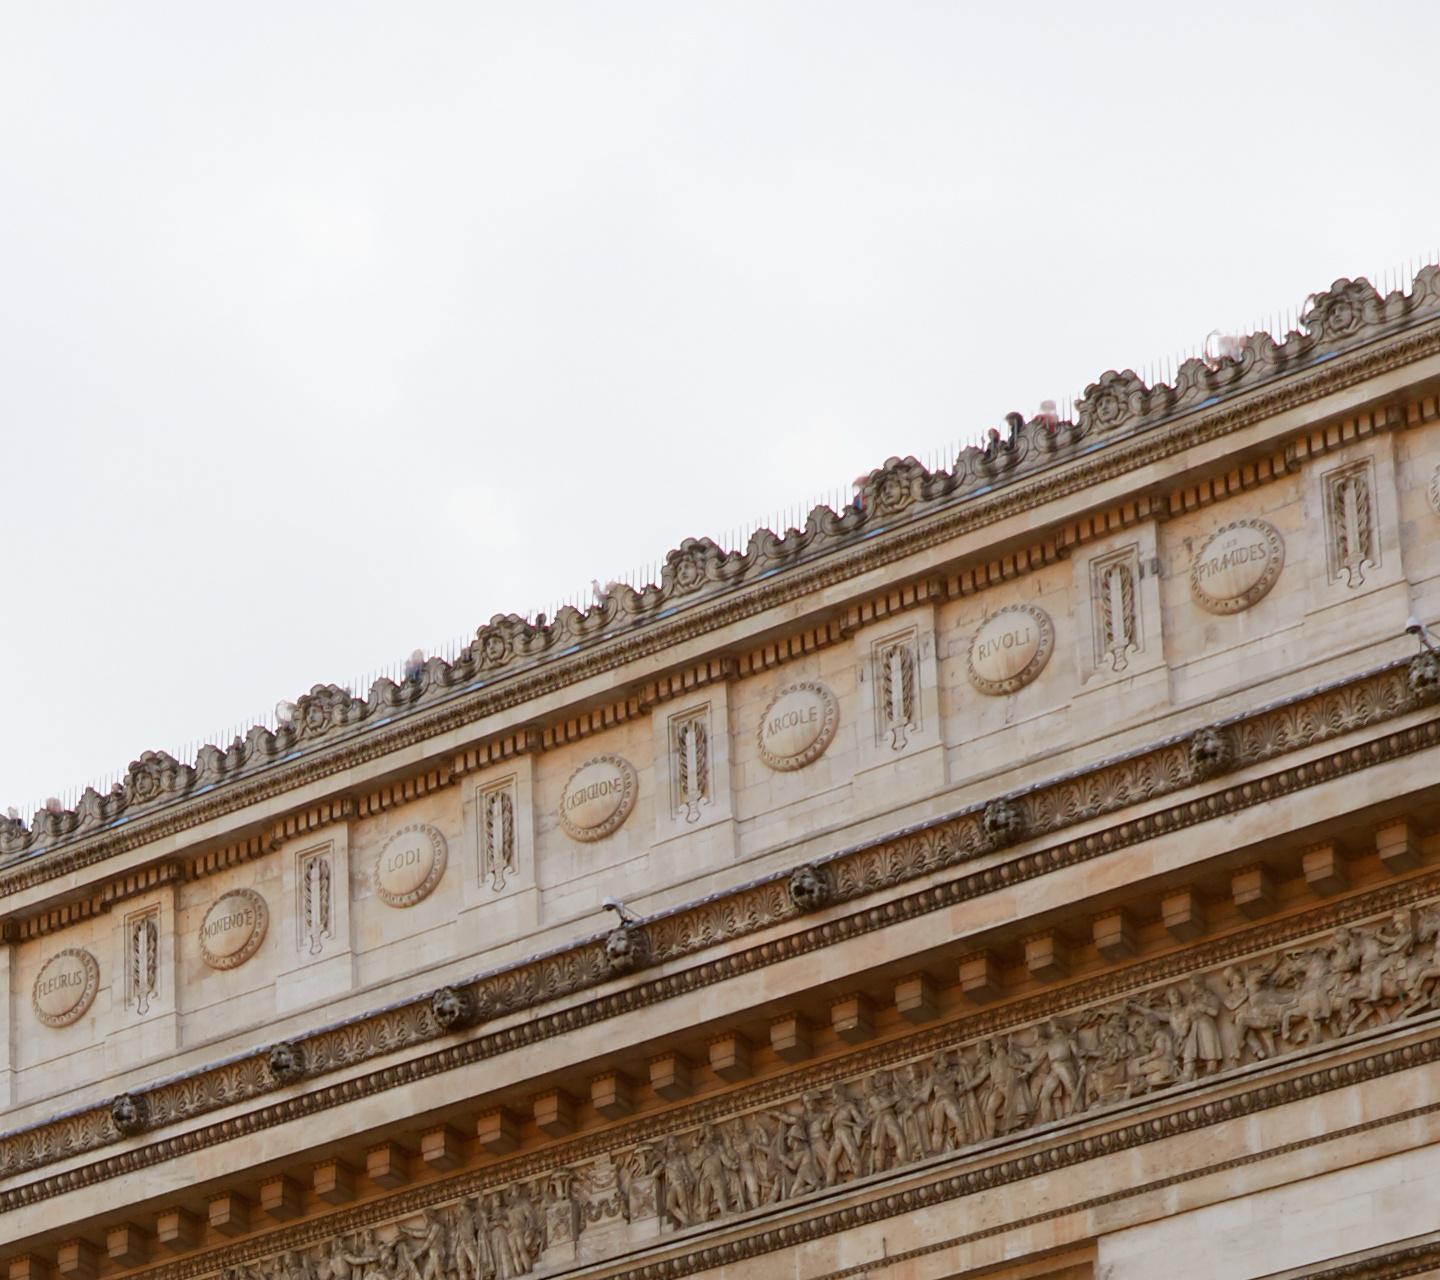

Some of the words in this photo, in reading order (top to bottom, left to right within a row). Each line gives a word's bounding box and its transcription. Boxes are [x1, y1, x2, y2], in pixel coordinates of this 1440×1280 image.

[1199, 542, 1266, 580] PYRAMIDES
[978, 627, 1030, 660] RIVOLI
[766, 706, 818, 738] ARCOLE
[387, 848, 420, 872] LODI
[38, 970, 82, 999] FLEURUS
